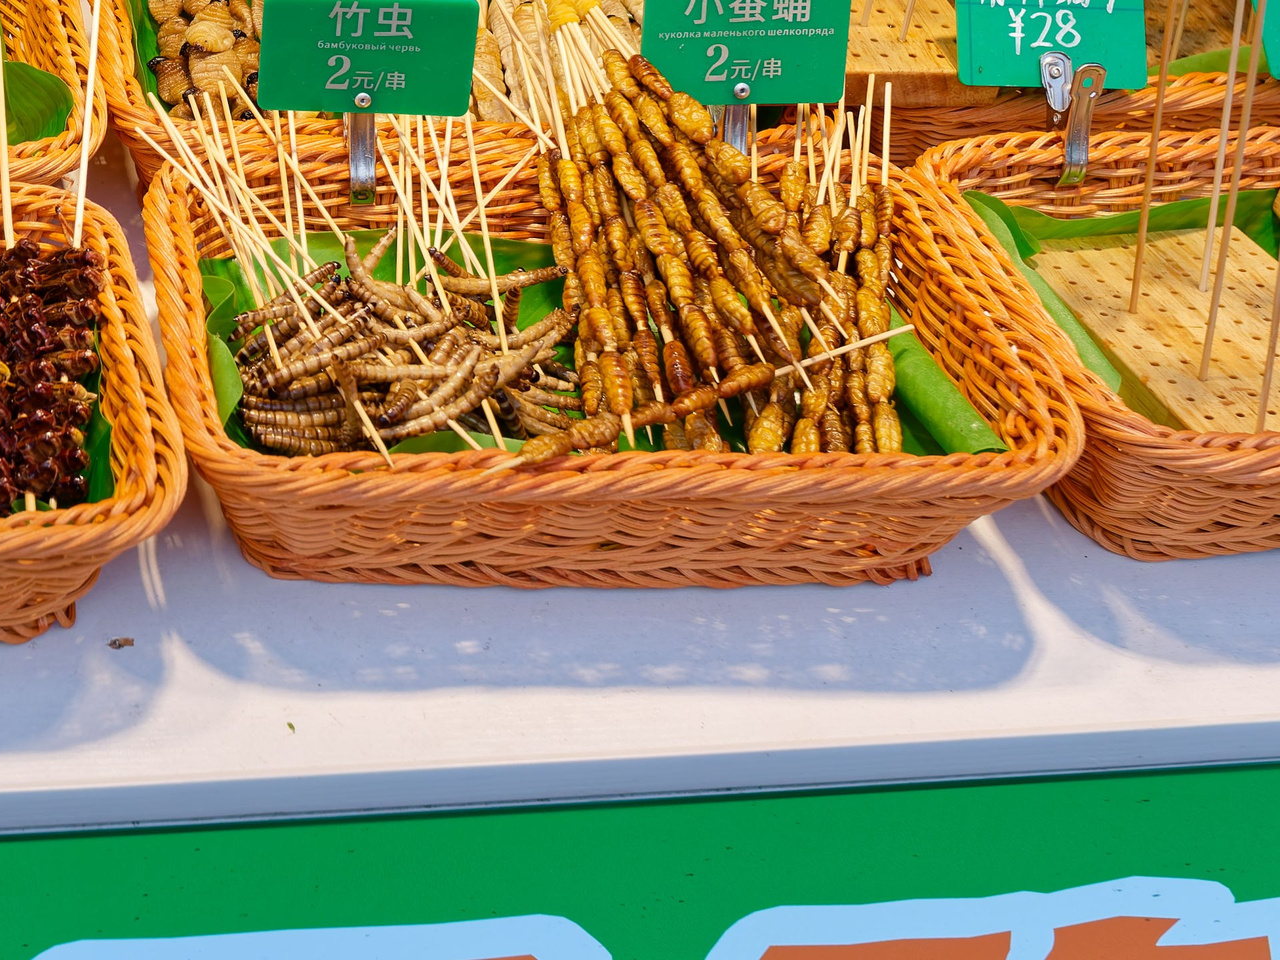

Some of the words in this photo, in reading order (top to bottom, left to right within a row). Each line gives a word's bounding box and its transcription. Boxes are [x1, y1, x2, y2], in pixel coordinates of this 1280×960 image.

[328, 0, 413, 39] 竹虫
[1008, 7, 1081, 56] ¥28
[317, 40, 386, 52] бамбуковый
[388, 43, 421, 53] червь
[658, 30, 701, 41] куколка
[703, 28, 766, 38] маленького
[767, 27, 835, 38] шелкопряда
